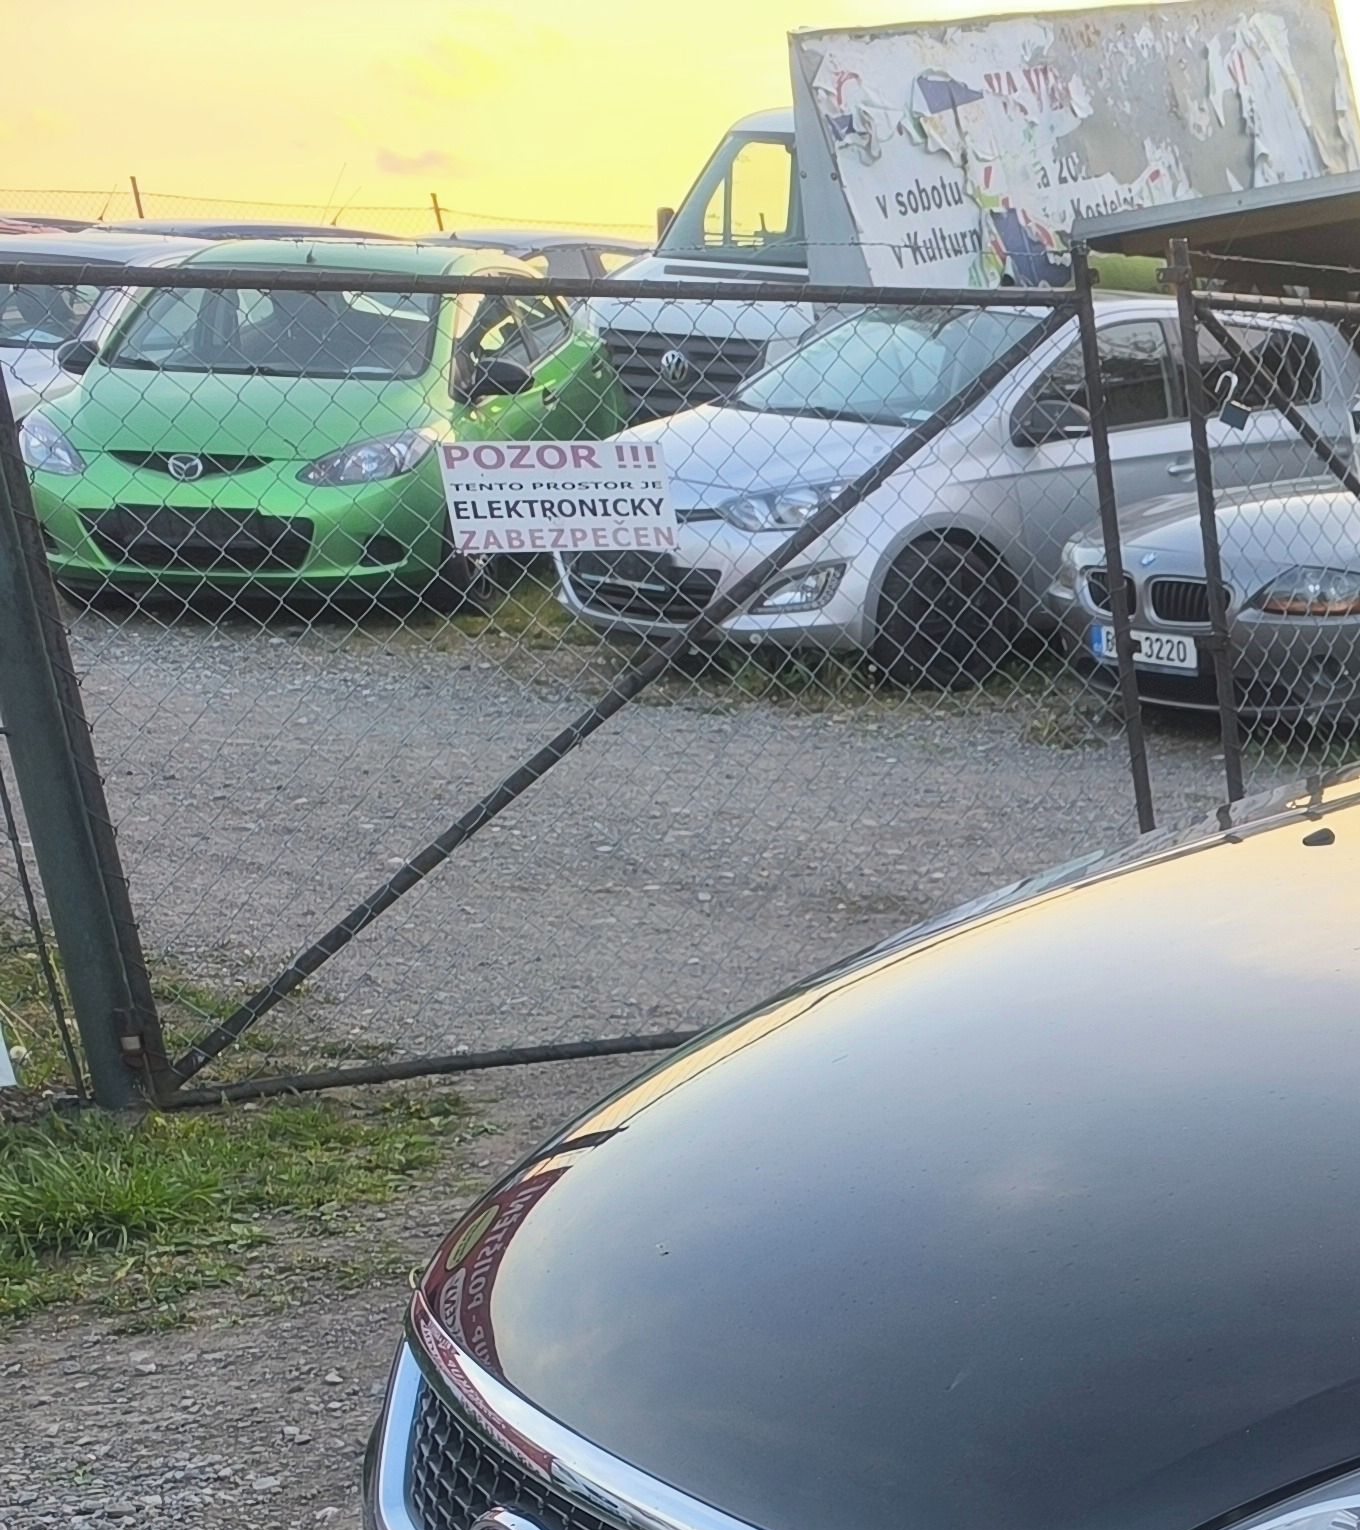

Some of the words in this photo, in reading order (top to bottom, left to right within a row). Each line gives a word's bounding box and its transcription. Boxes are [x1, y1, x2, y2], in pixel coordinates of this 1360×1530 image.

[898, 175, 964, 216] sobotu
[443, 445, 602, 470] POZOR
[615, 445, 657, 469] !!!
[451, 482, 524, 492] TENTO
[532, 480, 635, 491] PROSTOR
[641, 480, 663, 490] JE
[454, 498, 664, 520] ELEKTRONICKY
[459, 520, 675, 550] ZABEZPEČEN
[1145, 636, 1187, 663] 3220
